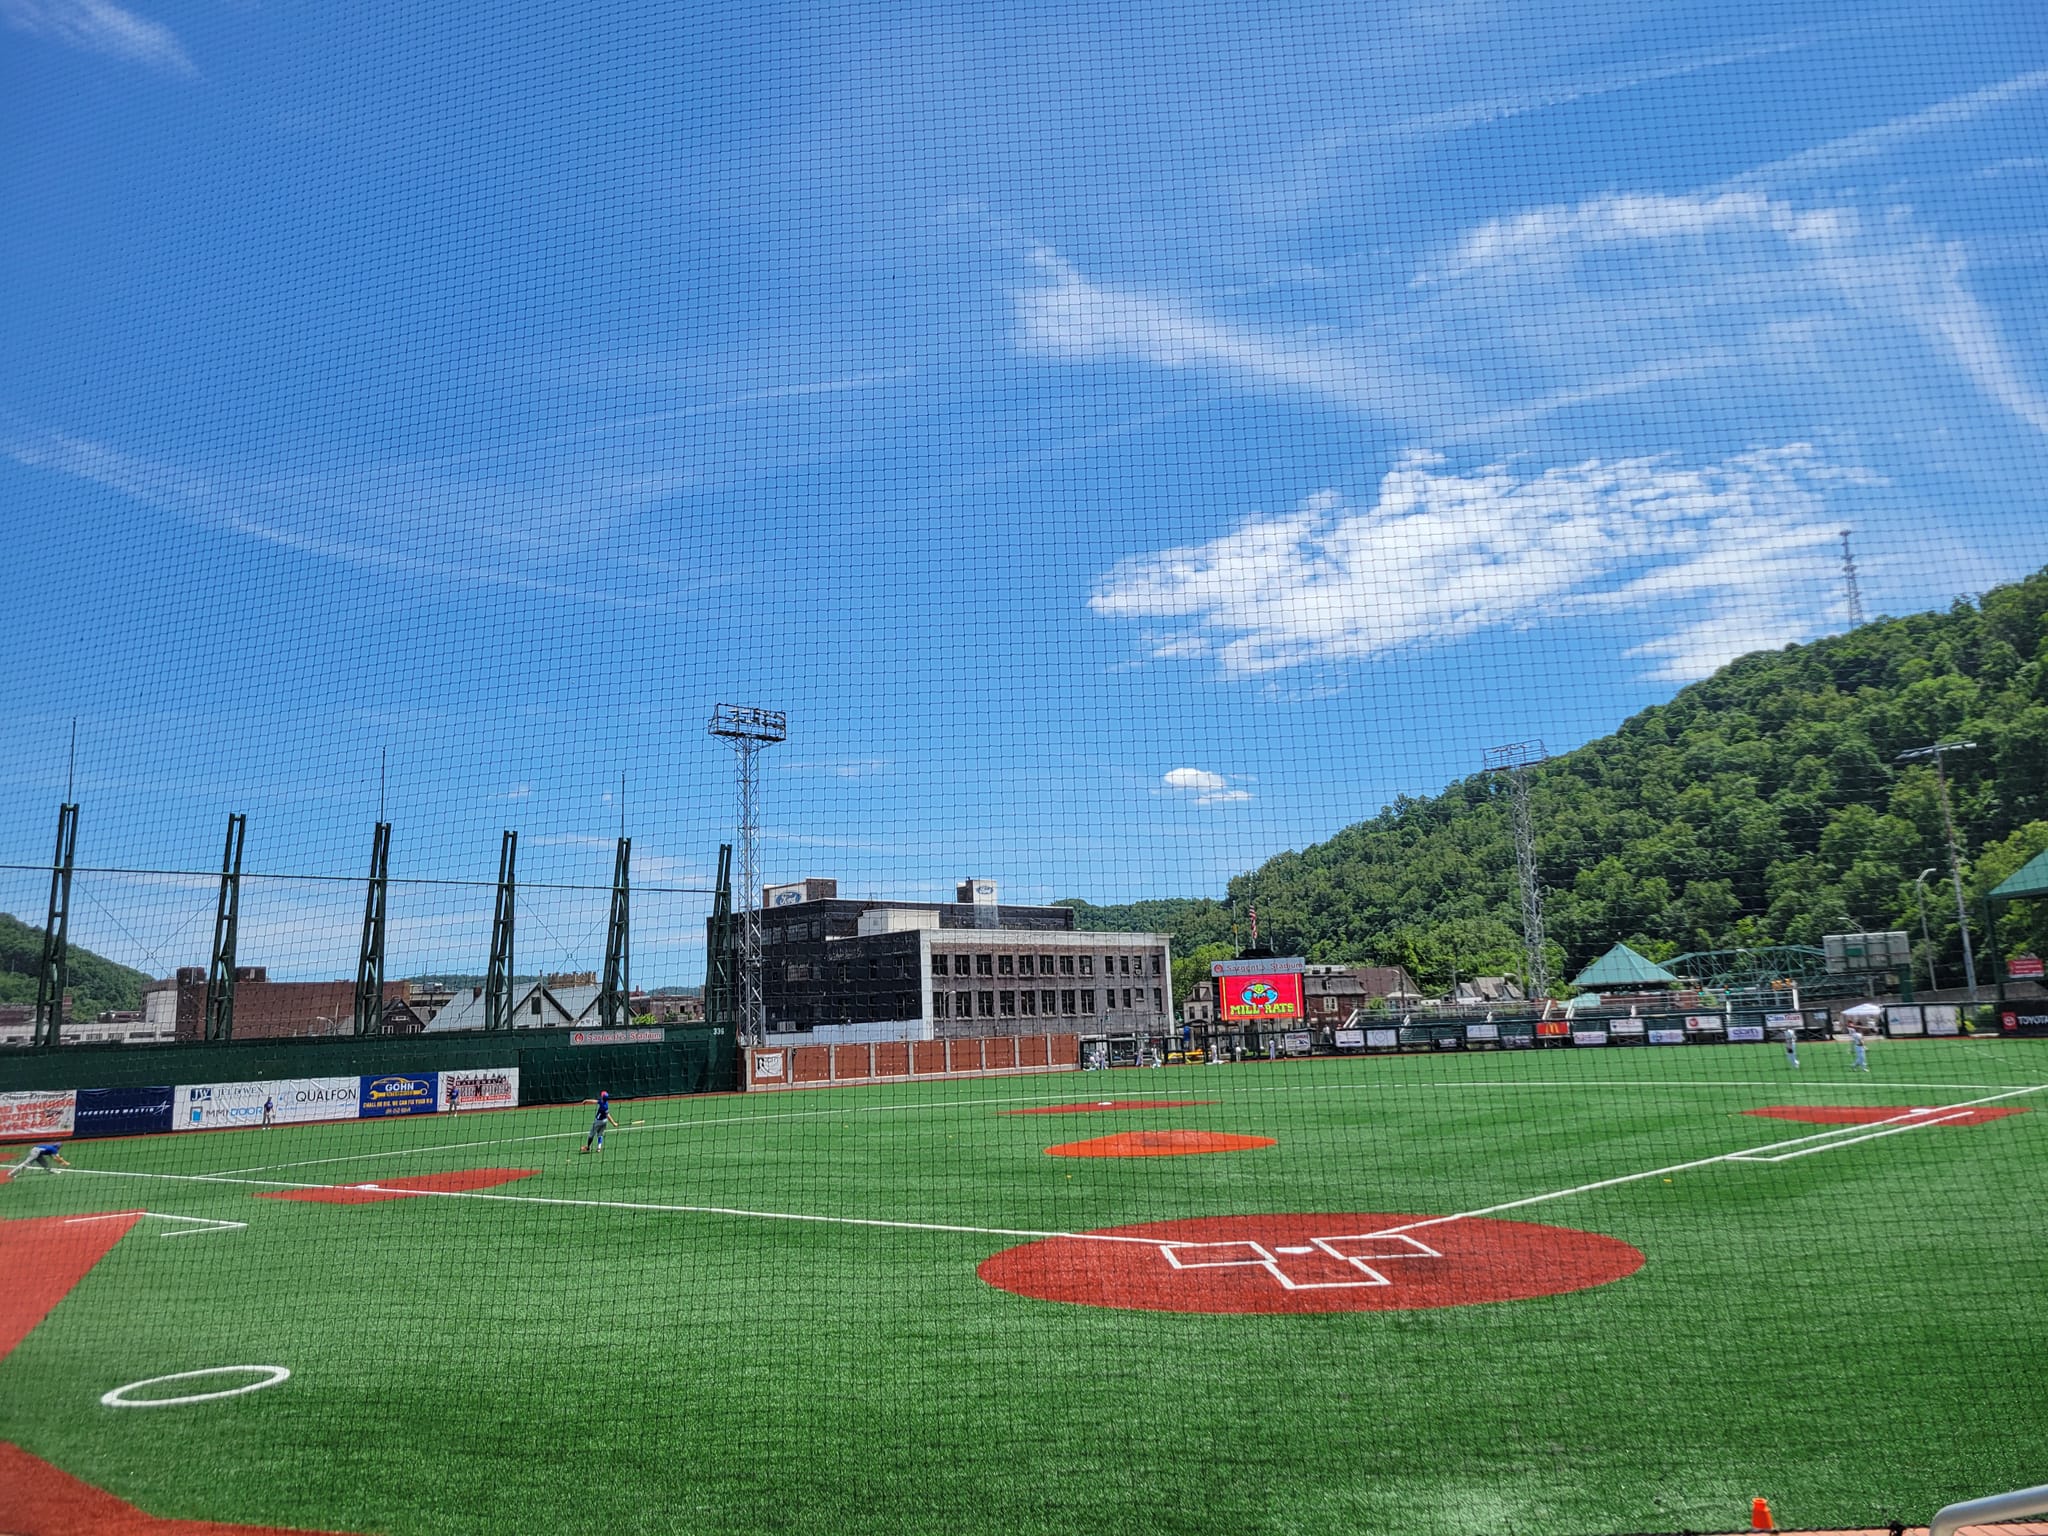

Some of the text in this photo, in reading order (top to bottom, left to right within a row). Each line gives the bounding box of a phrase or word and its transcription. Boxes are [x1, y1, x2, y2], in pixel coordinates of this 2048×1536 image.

[779, 893, 798, 904] Ford
[1270, 962, 1303, 971] Stadium
[1230, 1003, 1294, 1015] MILL RATS
[629, 1031, 662, 1041] Stadium
[385, 1082, 415, 1092] GOHN
[295, 1087, 357, 1102] QUALFON
